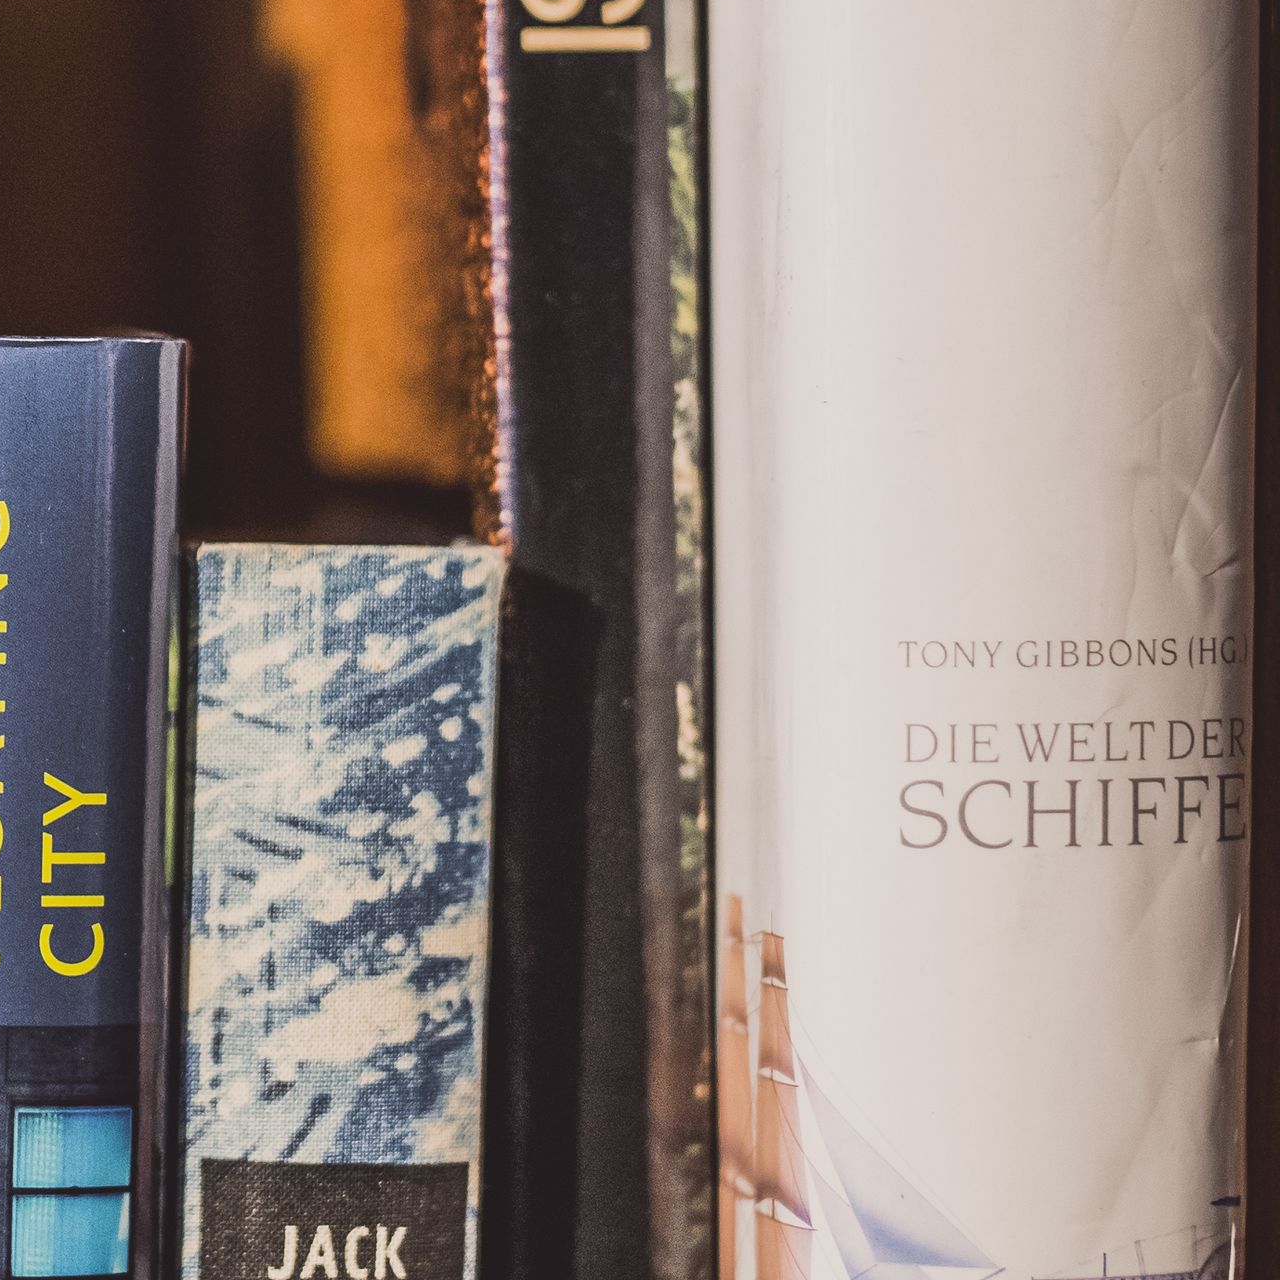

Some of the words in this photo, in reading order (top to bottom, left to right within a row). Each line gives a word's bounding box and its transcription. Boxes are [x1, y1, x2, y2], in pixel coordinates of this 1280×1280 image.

[898, 639, 1005, 669] TONY
[1015, 637, 1178, 669] GIBBONS
[904, 723, 1001, 764] DIE
[1018, 719, 1157, 763] WELT
[1167, 718, 1247, 761] DER
[899, 773, 1247, 850] SCHIFFE
[38, 771, 108, 977] CITY
